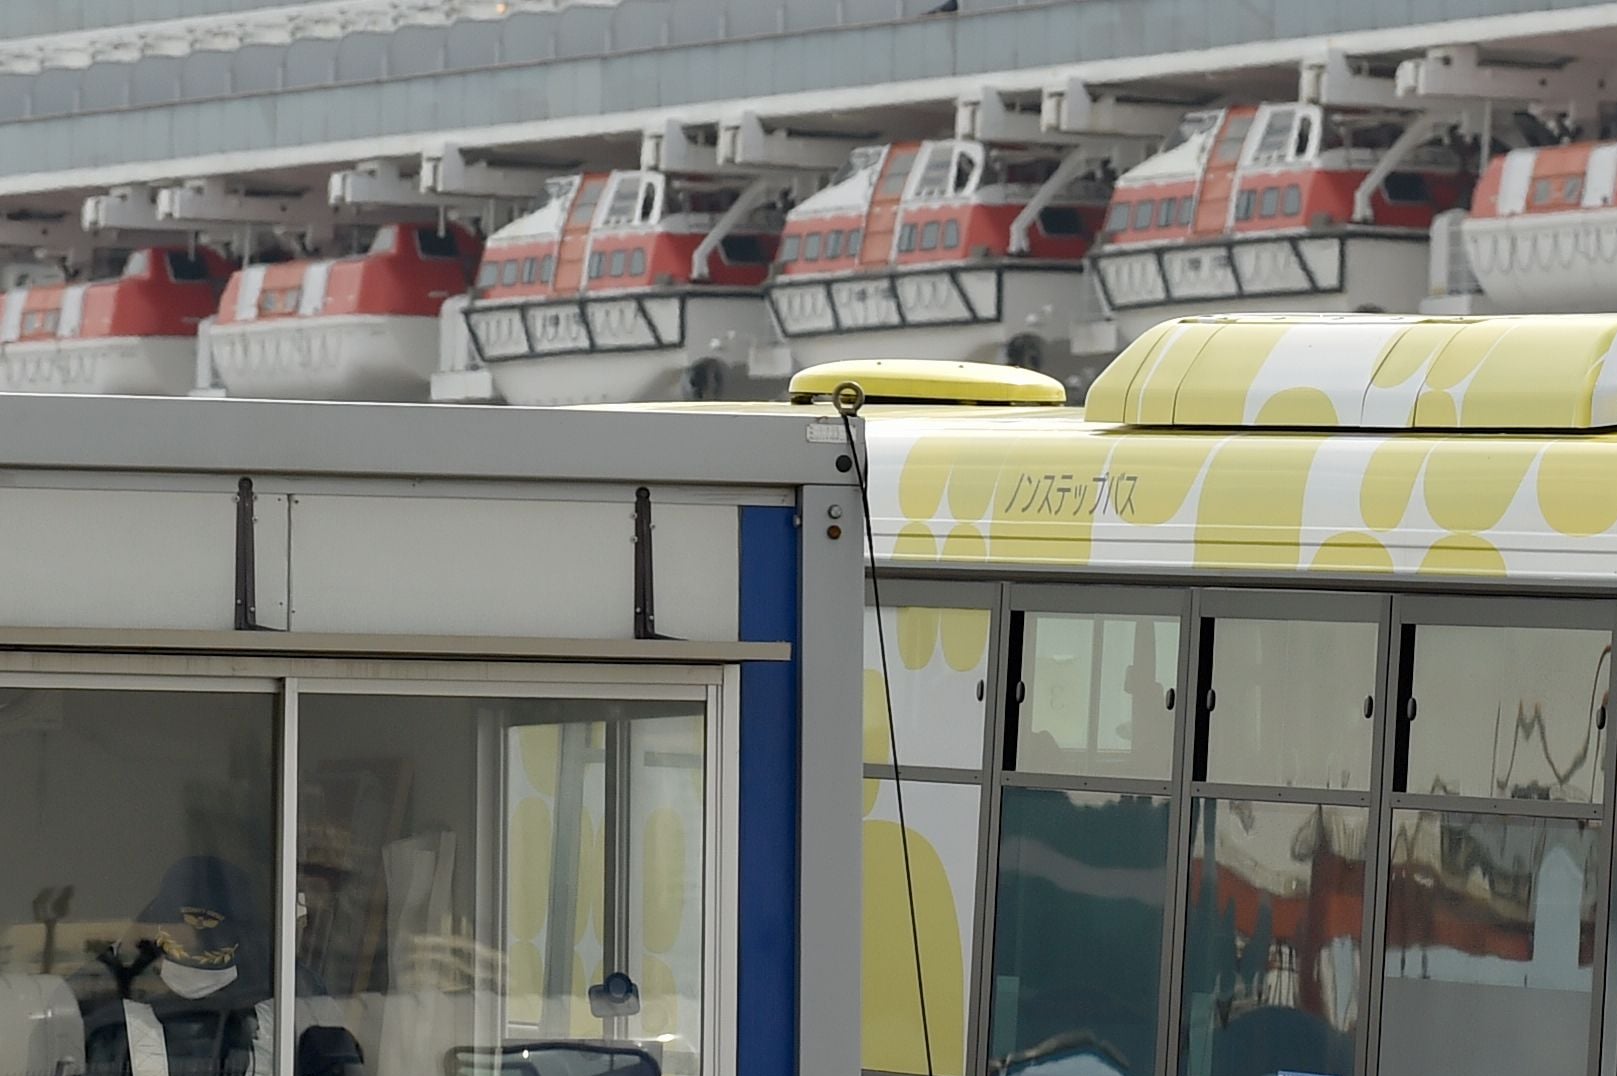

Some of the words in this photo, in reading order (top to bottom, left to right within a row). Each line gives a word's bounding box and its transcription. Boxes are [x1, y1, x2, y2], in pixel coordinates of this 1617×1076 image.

[1004, 472, 1138, 516] ノンステップバス
